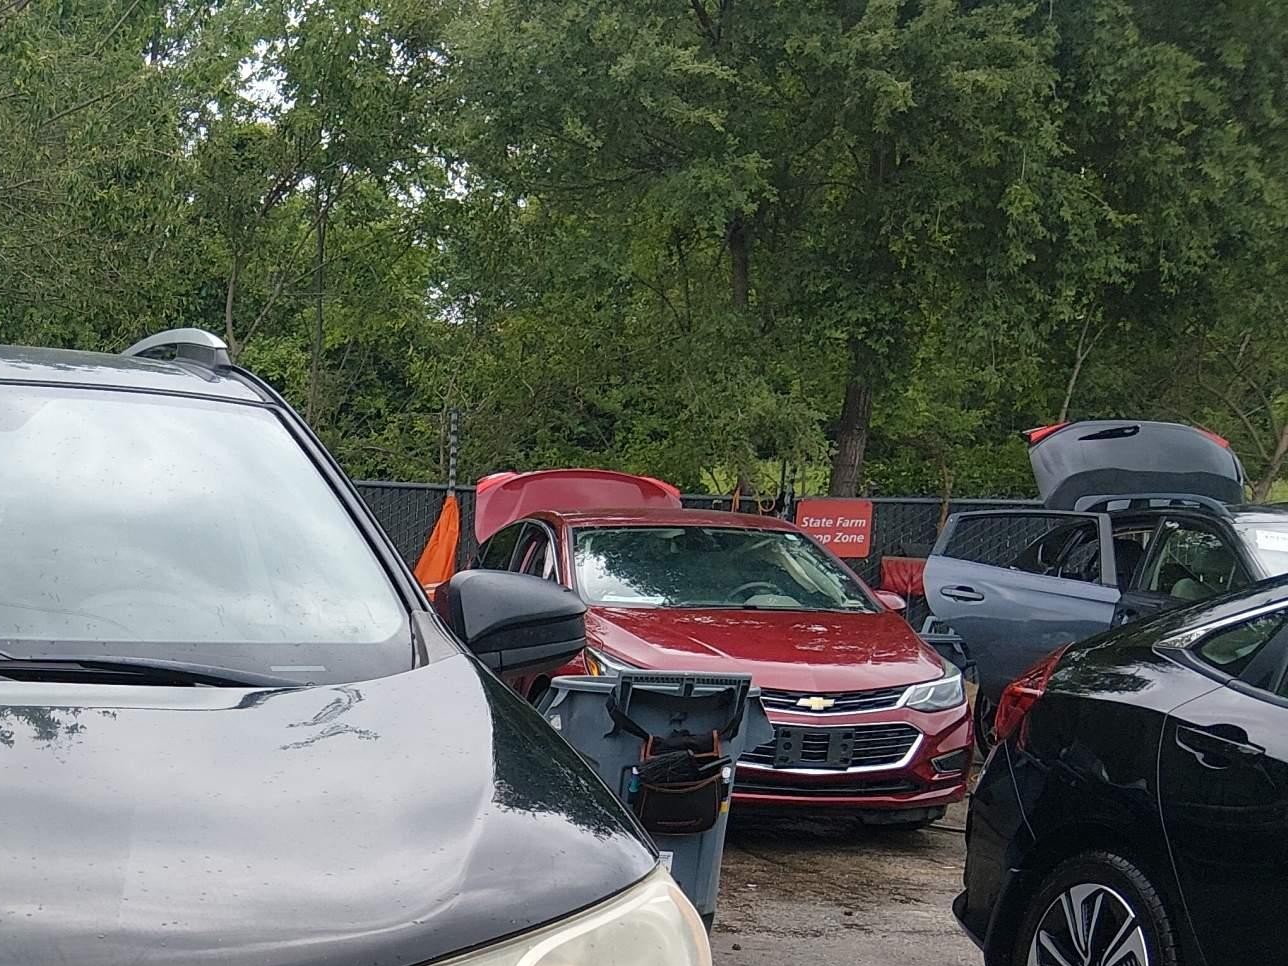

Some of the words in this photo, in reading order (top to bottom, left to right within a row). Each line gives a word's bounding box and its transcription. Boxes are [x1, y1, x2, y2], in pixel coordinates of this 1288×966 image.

[800, 516, 833, 528] State
[836, 516, 866, 528] Farm
[833, 532, 865, 543] Zone
